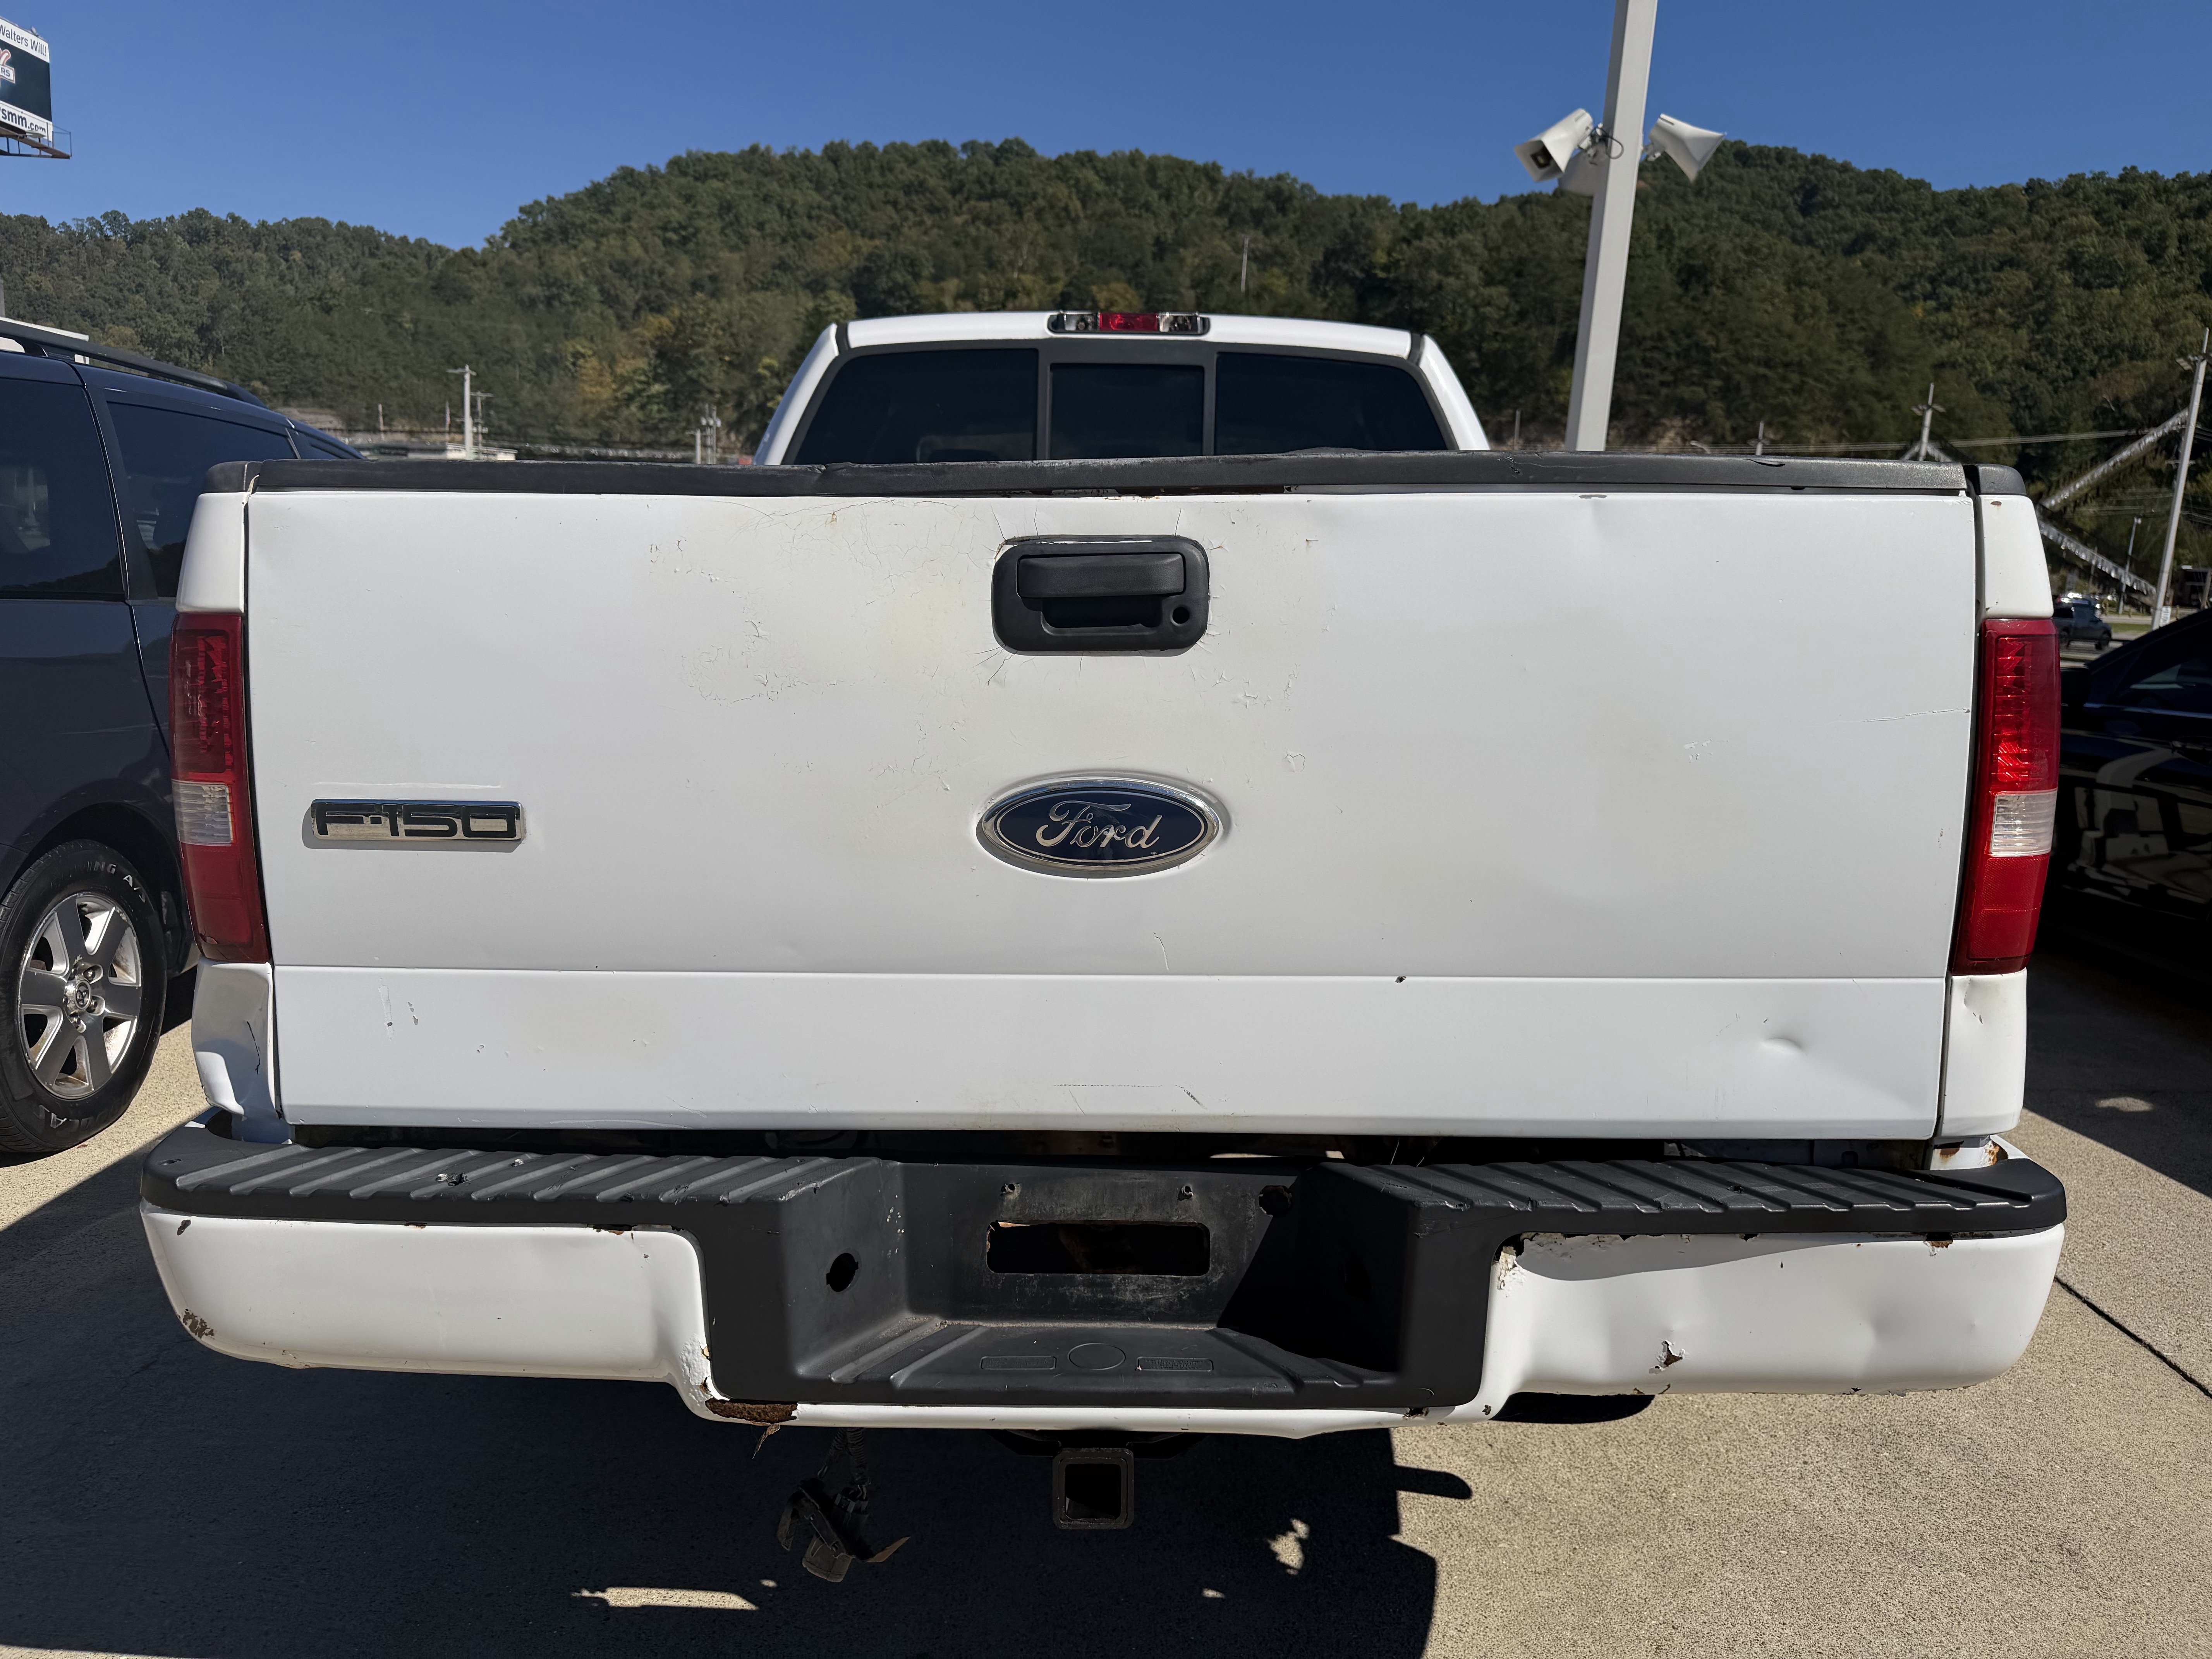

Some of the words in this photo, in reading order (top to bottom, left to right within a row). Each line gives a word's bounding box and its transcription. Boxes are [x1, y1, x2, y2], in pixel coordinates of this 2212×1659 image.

[0, 24, 28, 47] Walters
[30, 38, 46, 56] Will!
[0, 107, 46, 133] smm.com
[315, 803, 517, 838] F-150
[1036, 800, 1163, 848] Ford
